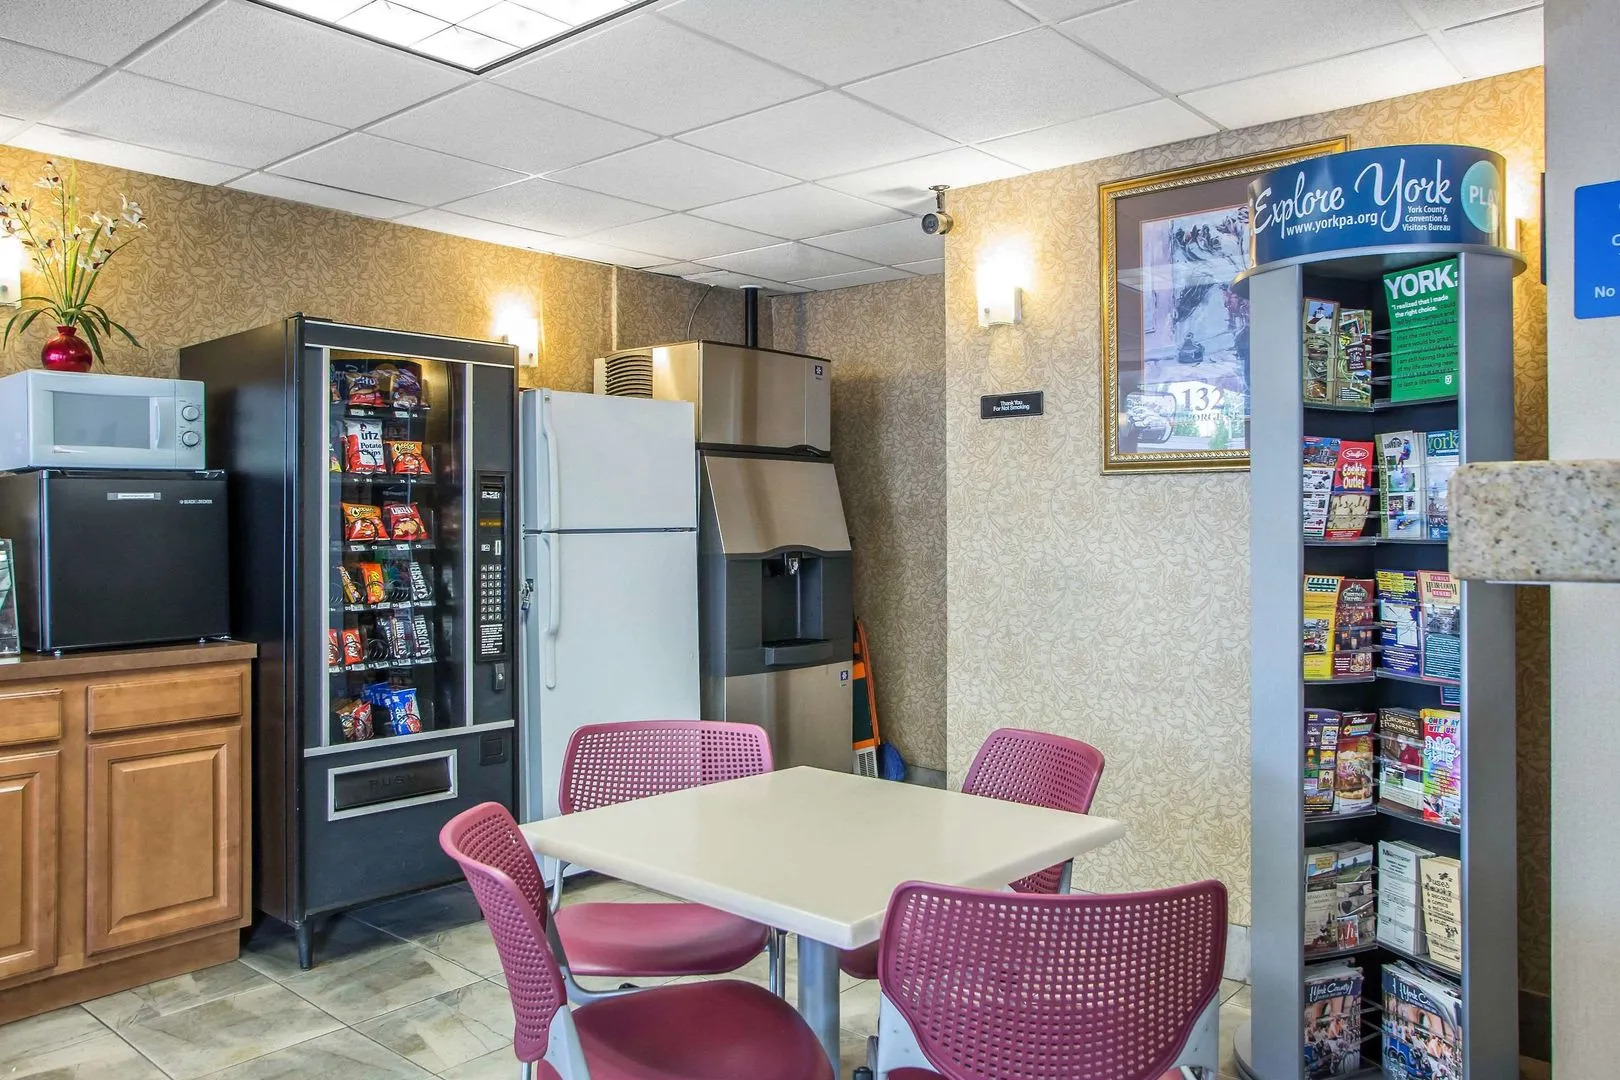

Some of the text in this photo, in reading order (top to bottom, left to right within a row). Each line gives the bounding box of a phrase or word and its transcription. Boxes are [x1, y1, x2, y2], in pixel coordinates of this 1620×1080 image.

[1253, 158, 1452, 240] Explore York
[1407, 205, 1447, 214] York County
[1286, 211, 1378, 237] www.yorkpa.org
[1405, 214, 1449, 223] Convention &
[1402, 223, 1451, 231] Visitors Bureau
[1594, 285, 1616, 298] No
[1396, 300, 1418, 310] realized
[1433, 294, 1449, 303] made
[1405, 307, 1418, 317] right
[1182, 387, 1225, 411] 132
[1010, 403, 1030, 411] Smoking
[360, 442, 382, 450] Potato
[1342, 461, 1367, 477] Cookie
[1343, 475, 1365, 489] Outlet
[369, 773, 417, 790] PUSH
